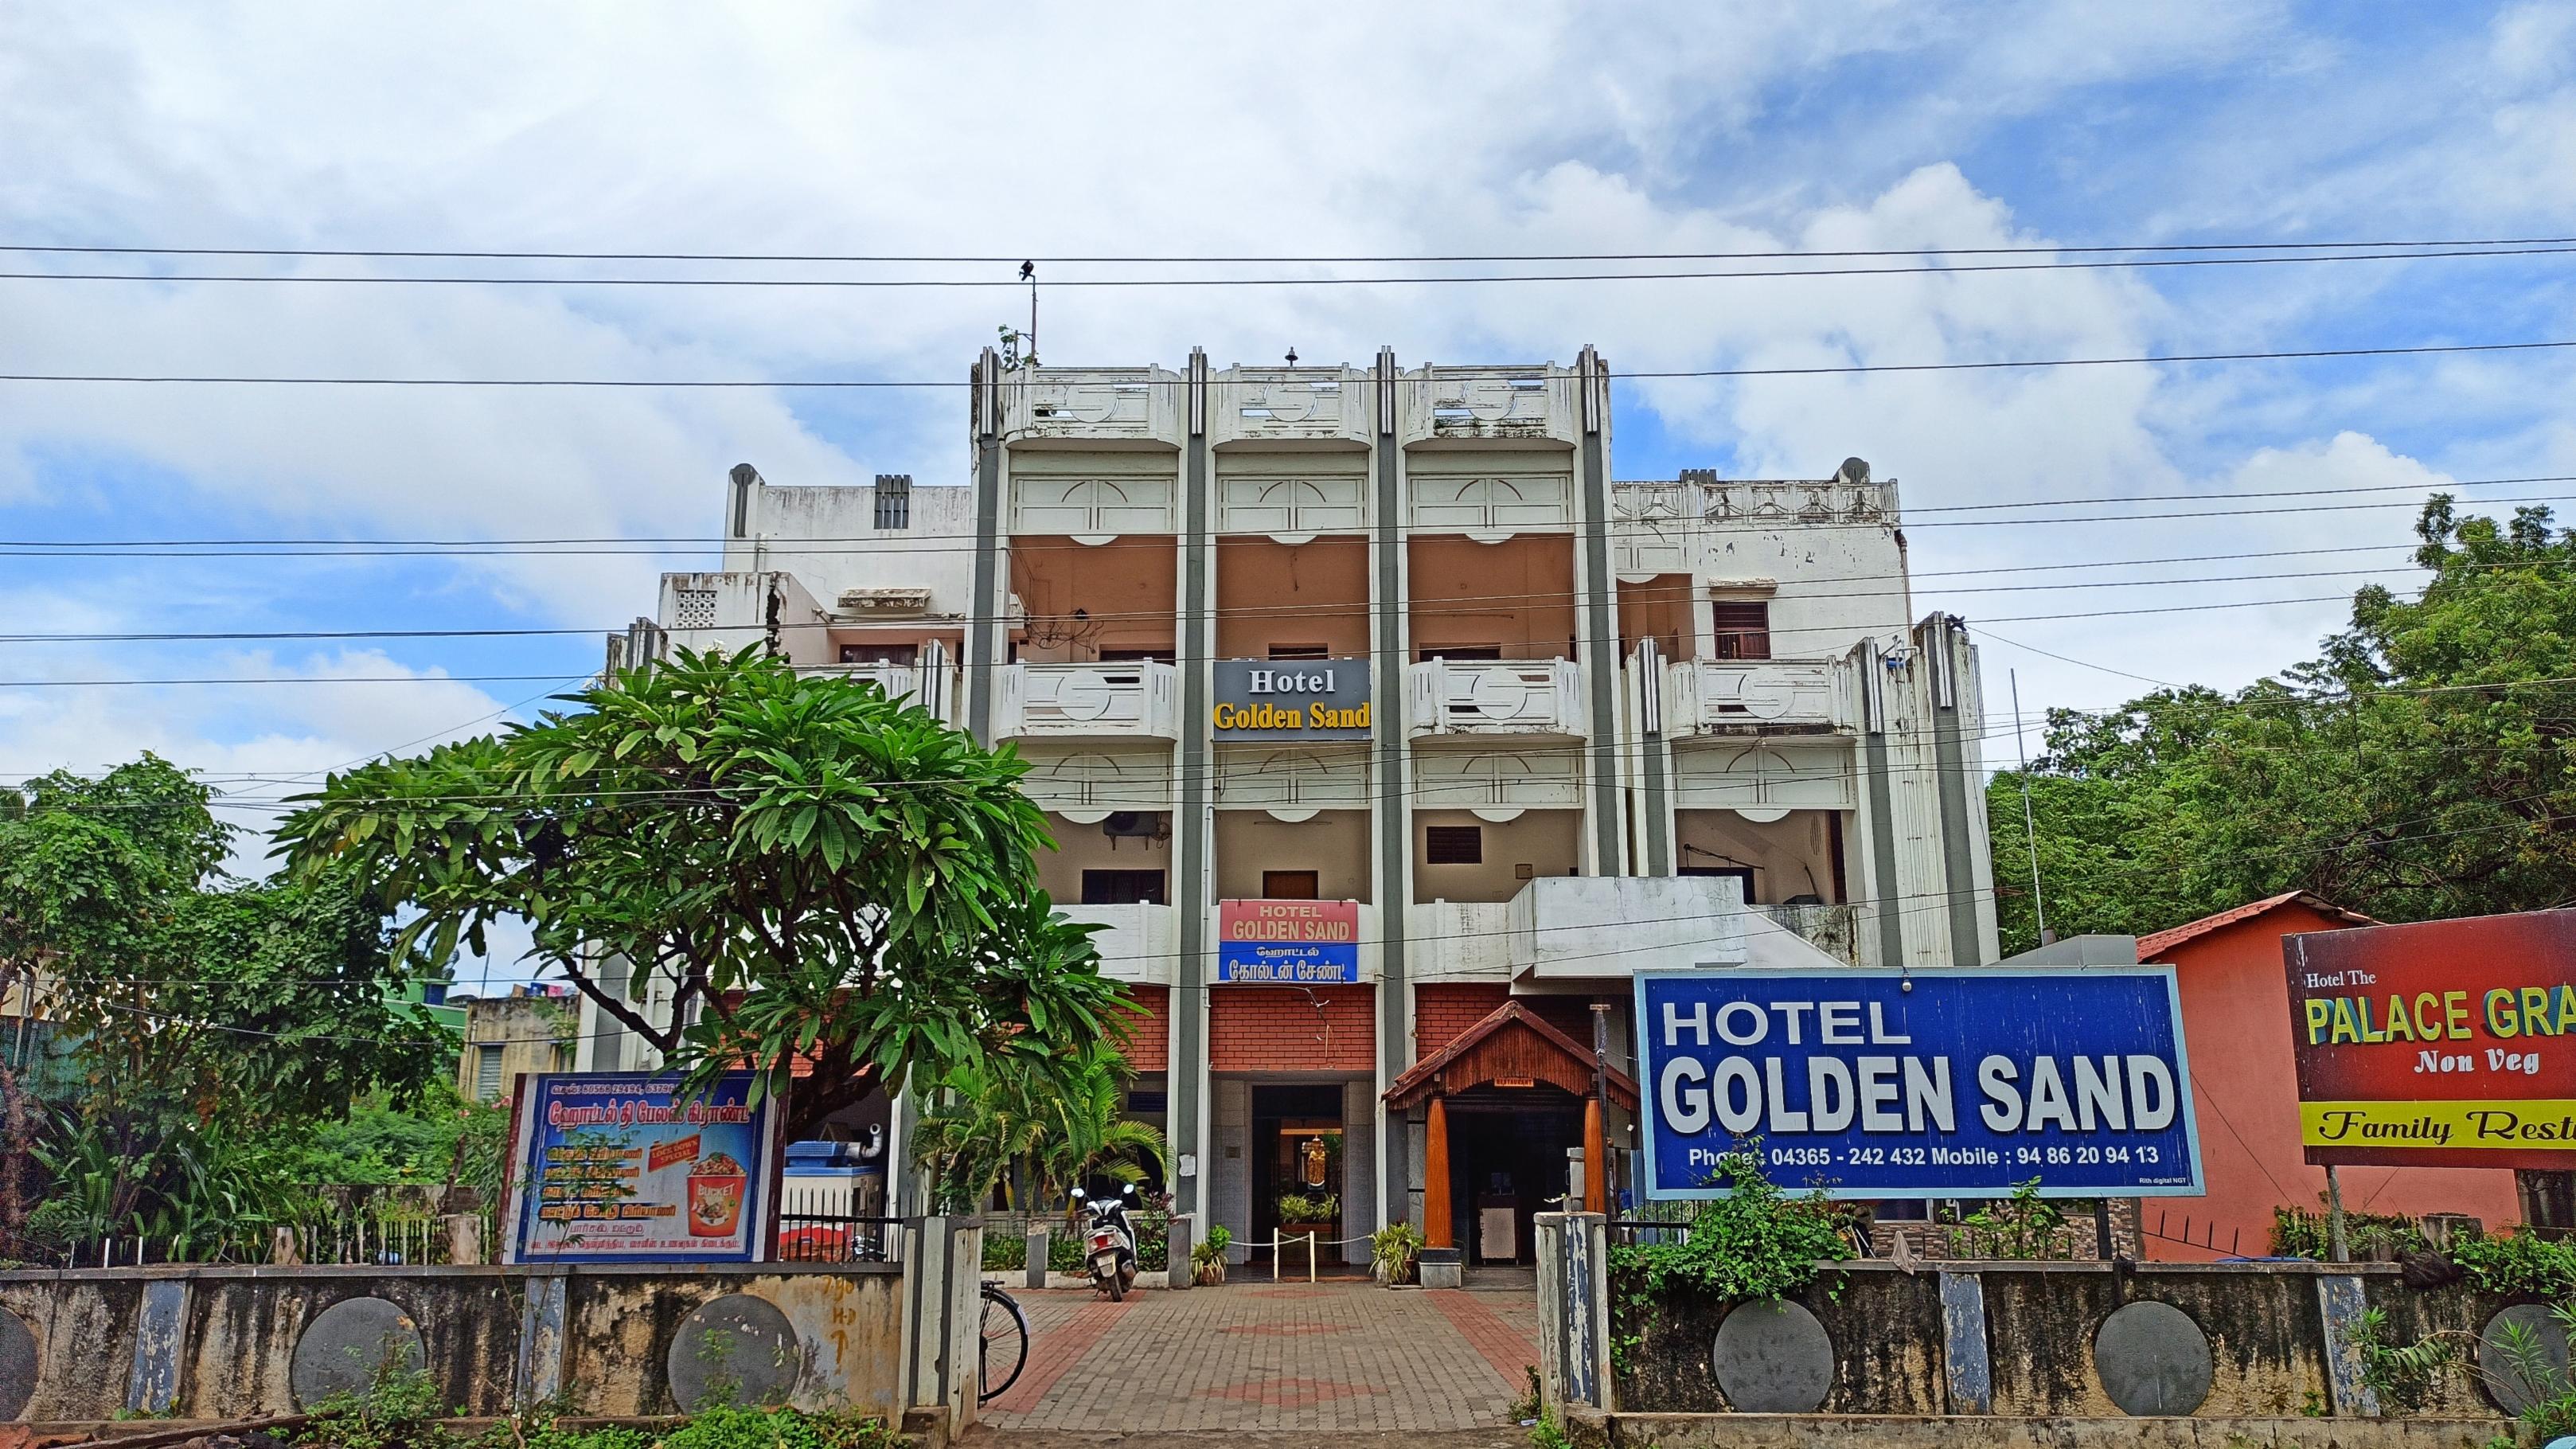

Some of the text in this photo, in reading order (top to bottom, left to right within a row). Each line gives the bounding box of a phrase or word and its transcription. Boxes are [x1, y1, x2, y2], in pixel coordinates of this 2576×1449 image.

[1248, 669, 1336, 693] Hotel
[1213, 701, 1371, 730] Golden Sand
[1259, 906, 1322, 917] HOTEL
[1232, 920, 1350, 940] GOLDEN SAND
[1256, 946, 1319, 959] ஹோட்டல்
[1228, 959, 1347, 980] கோல்டன் சேண்ட்
[2306, 970, 2377, 988] Hotel The
[1662, 1001, 1911, 1046] HOTEL
[2305, 985, 2576, 1045] PALACE GRA
[2414, 1048, 2540, 1075] Non Veg
[1660, 1053, 2176, 1135] GOLDEN SAND
[548, 1098, 619, 1131] ஹோட்டல்
[620, 1100, 634, 1130] தி
[2318, 1111, 2453, 1145] Family
[1771, 1147, 1830, 1166] 04365
[1849, 1147, 1884, 1165] 242
[1890, 1147, 1926, 1165] 432
[1932, 1147, 1999, 1165] Mobile
[2017, 1146, 2041, 1165] 94
[2047, 1146, 2071, 1164] 86
[2076, 1146, 2100, 1164] 20
[2105, 1146, 2129, 1164] 94
[2135, 1146, 2159, 1163] 13
[698, 1183, 735, 1196] BUCKET
[622, 1203, 677, 1217] பிரியாணி
